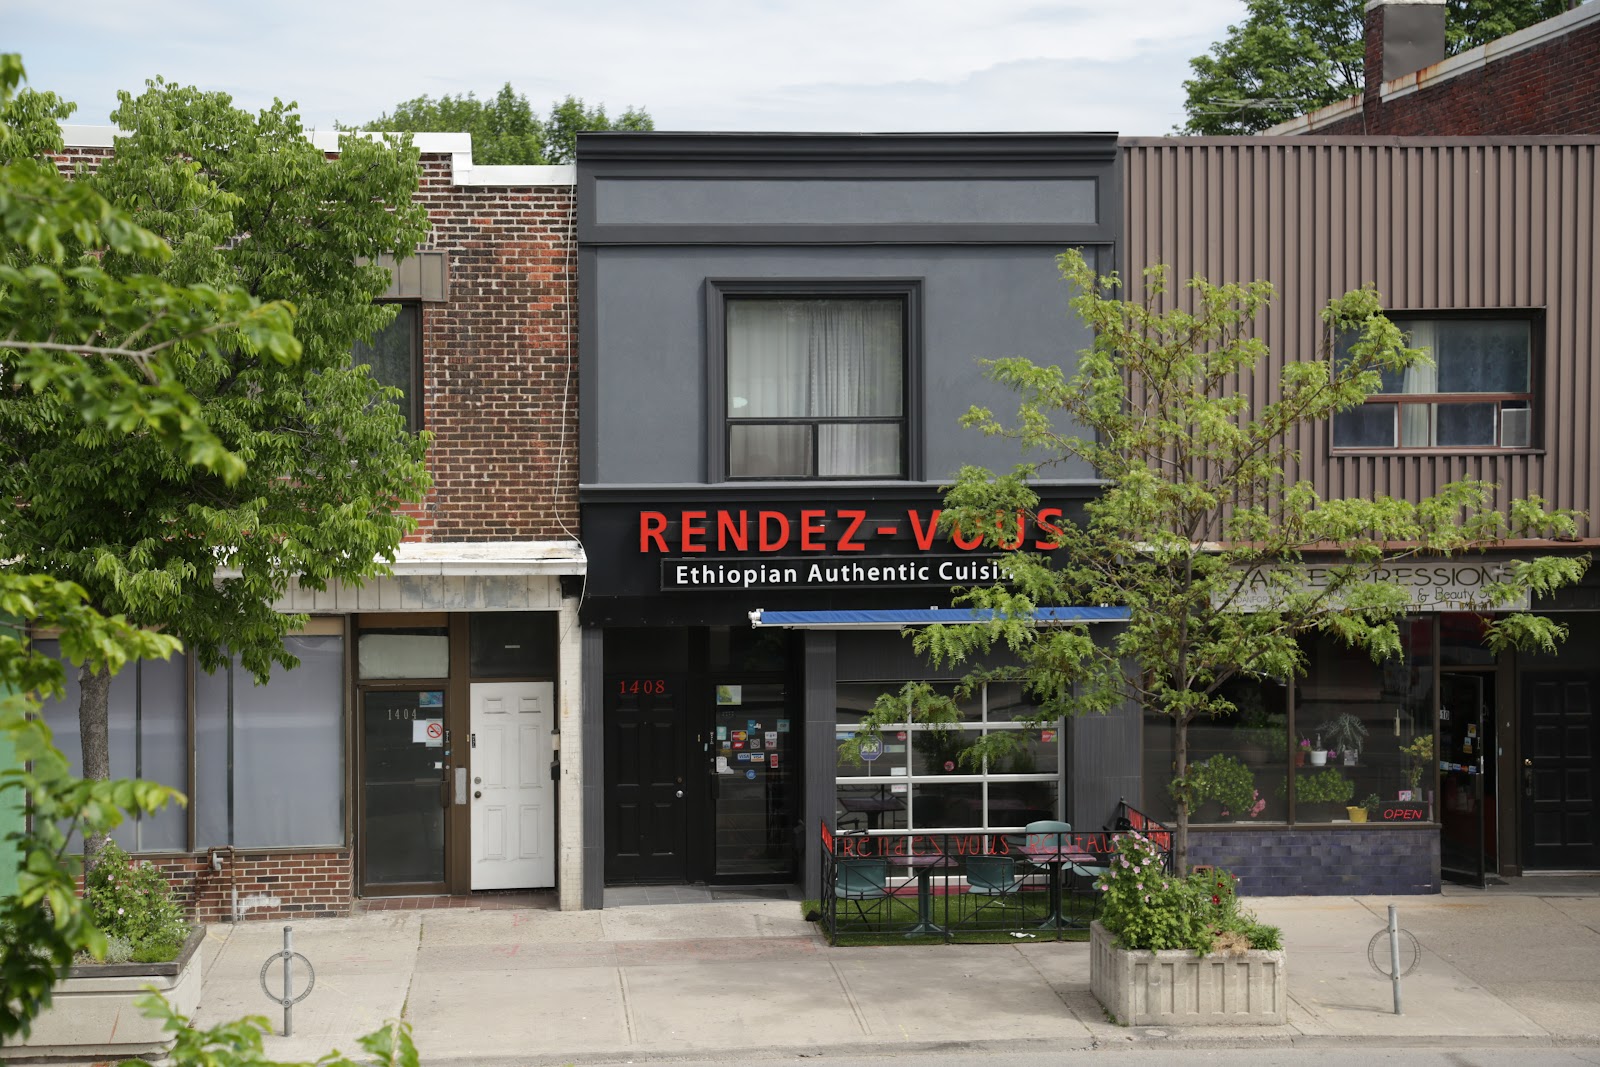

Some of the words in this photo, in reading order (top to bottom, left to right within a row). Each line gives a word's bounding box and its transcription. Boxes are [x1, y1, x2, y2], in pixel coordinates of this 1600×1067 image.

[639, 507, 1065, 553] RENDEZ-VOUS
[676, 564, 798, 588] Ethiopian
[807, 562, 930, 584] Authentic
[938, 561, 1014, 581] Cuisin
[1435, 586, 1475, 601] Beauty
[619, 679, 665, 694] 1408
[387, 708, 417, 721] 1404
[1383, 808, 1423, 819] OPEN
